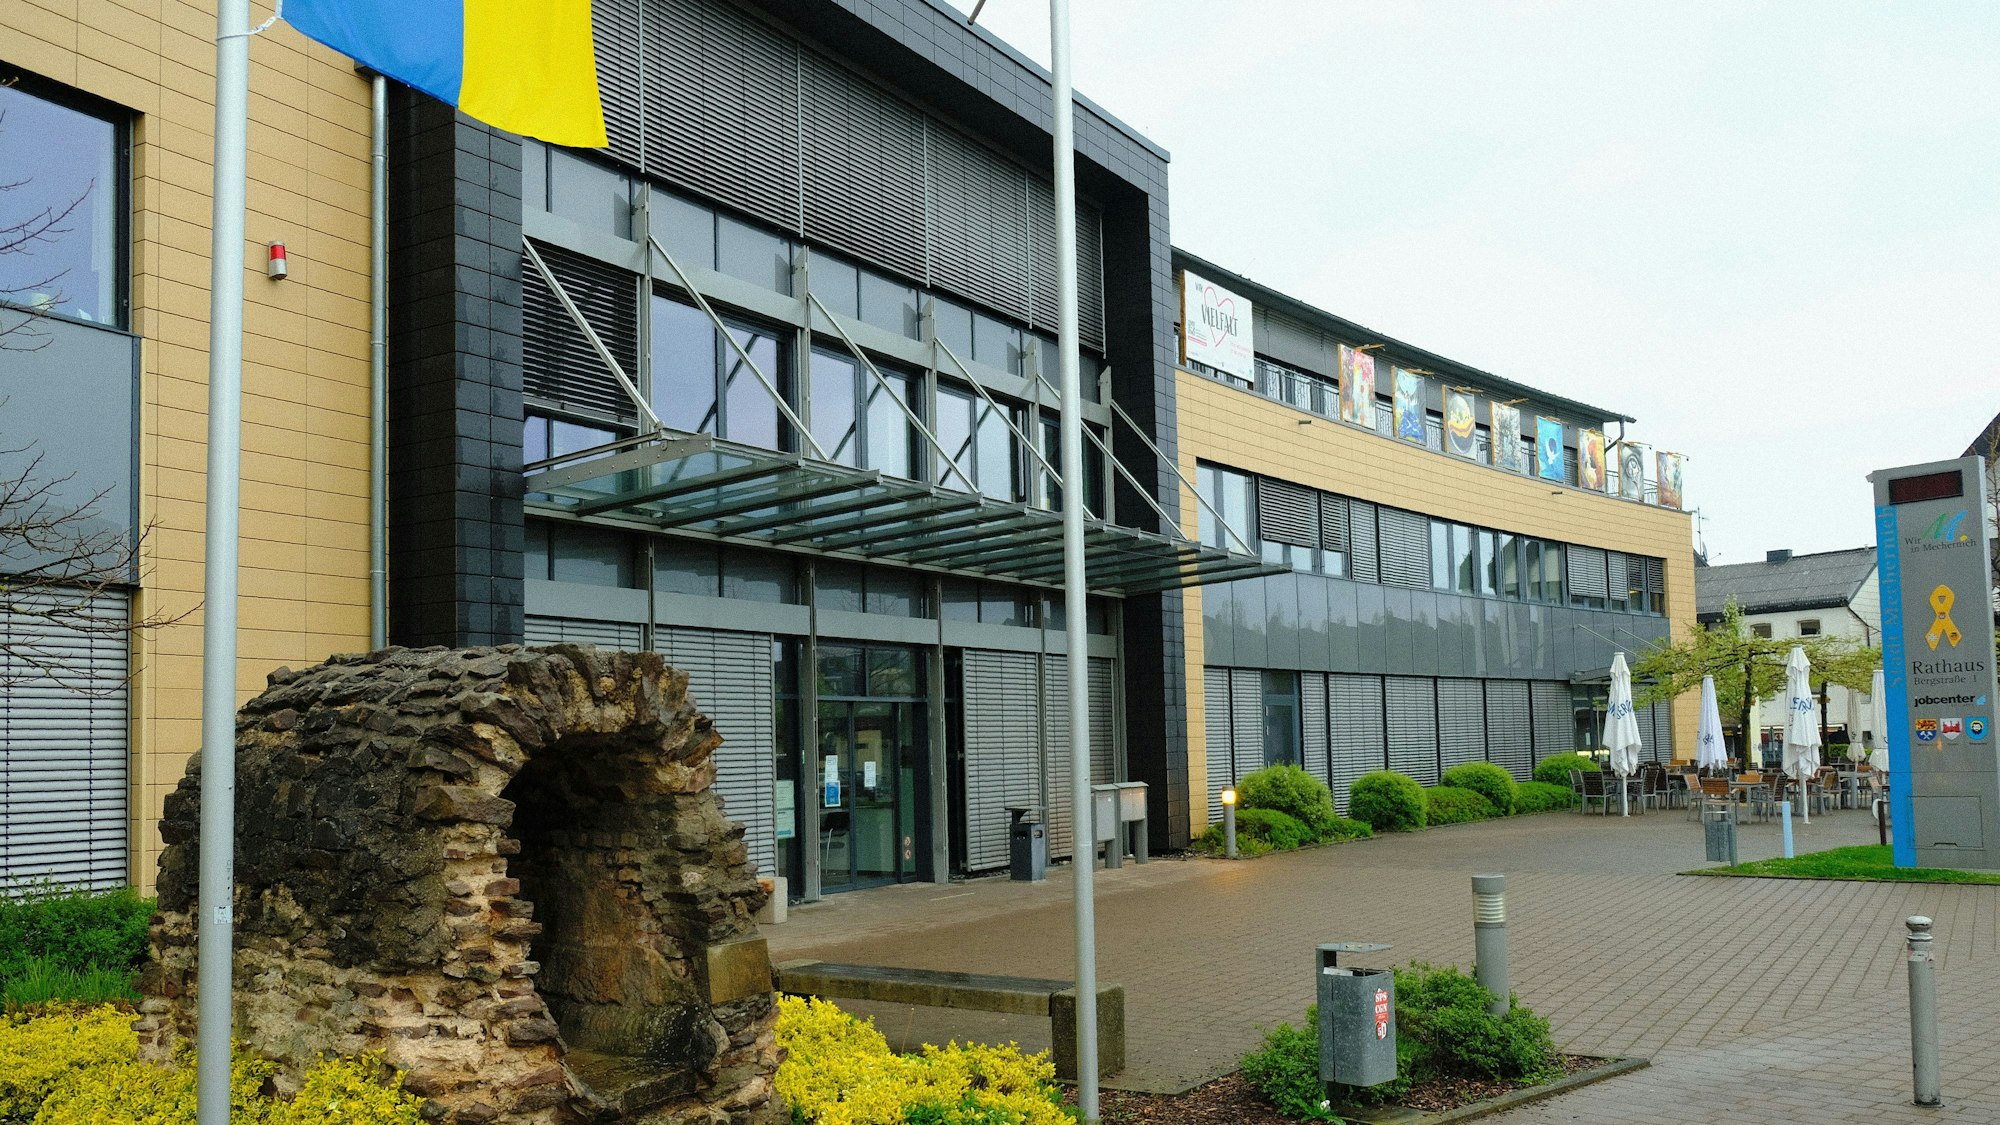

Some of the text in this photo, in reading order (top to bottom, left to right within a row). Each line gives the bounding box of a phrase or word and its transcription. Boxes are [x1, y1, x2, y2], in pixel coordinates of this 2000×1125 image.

[1201, 303, 1238, 337] VIELFALT
[1904, 536, 1922, 546] Wir
[1911, 539, 1977, 553] in Mechernich
[1878, 506, 1903, 688] Stadt Mechernich
[1912, 659, 1985, 675] Rathaus
[1914, 675, 1967, 686] Bergstraße
[1914, 694, 1976, 708] jobcenter
